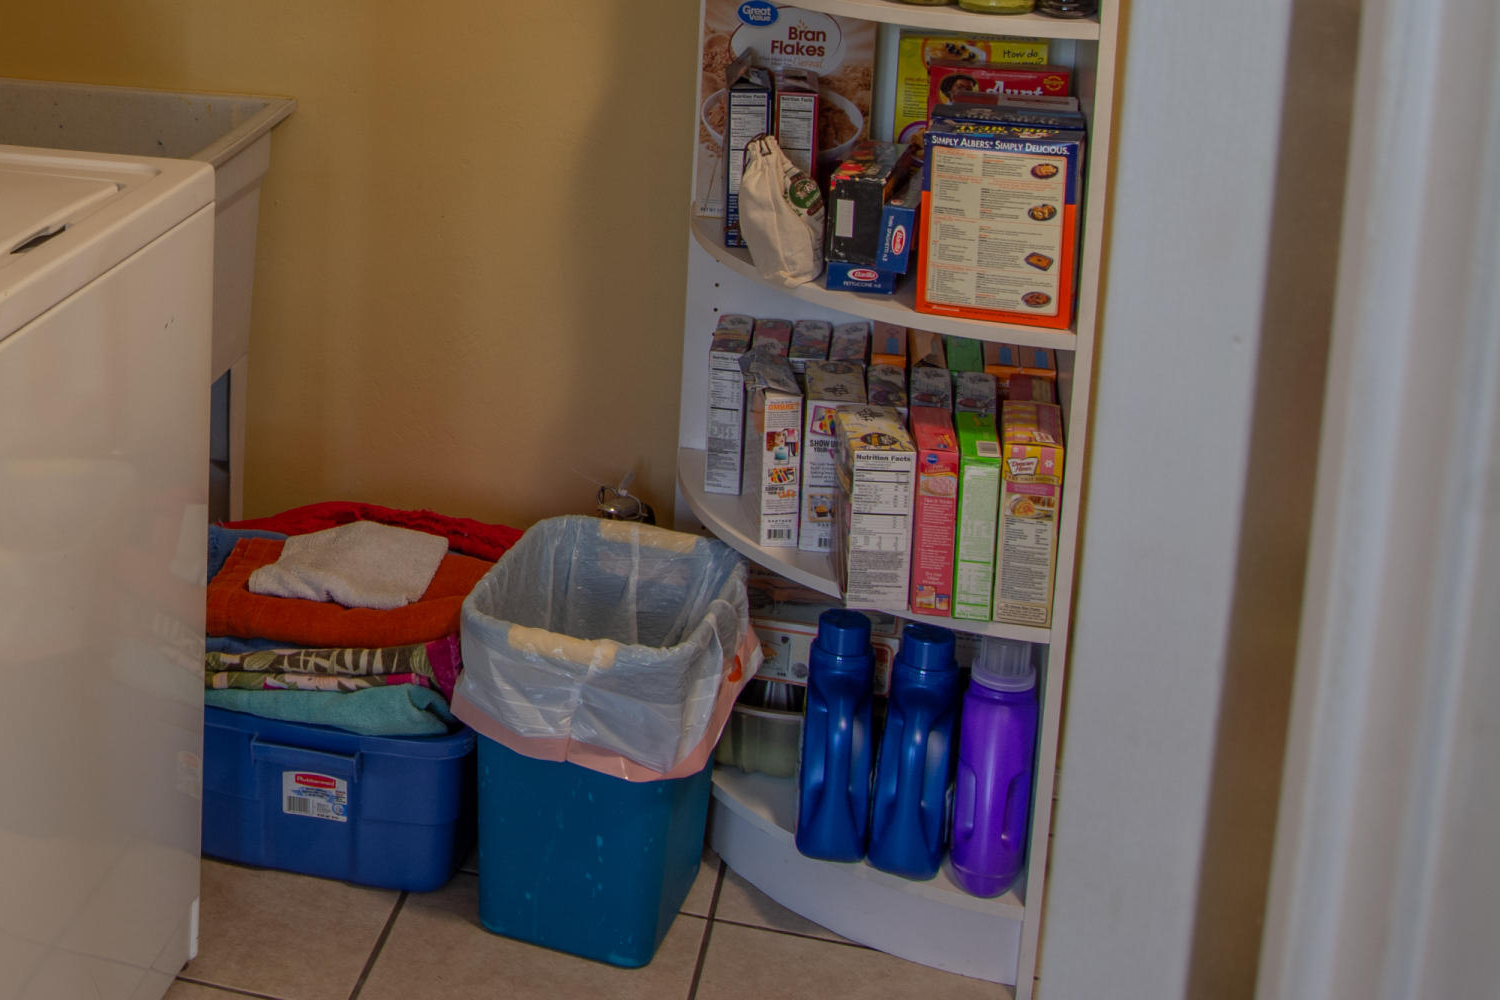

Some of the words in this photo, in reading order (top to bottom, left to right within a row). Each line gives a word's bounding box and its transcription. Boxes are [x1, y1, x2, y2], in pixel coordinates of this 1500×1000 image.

[742, 5, 771, 16] Great
[749, 13, 771, 22] Value
[788, 26, 827, 42] Bran
[771, 40, 826, 57] Flakes
[1003, 49, 1025, 59] How
[1026, 49, 1038, 58] do
[932, 135, 959, 147] SIMPLY
[995, 140, 1023, 151] SIMPLY
[810, 440, 830, 448] SHOW
[856, 453, 889, 462] Nutrition
[890, 454, 912, 462] Facts
